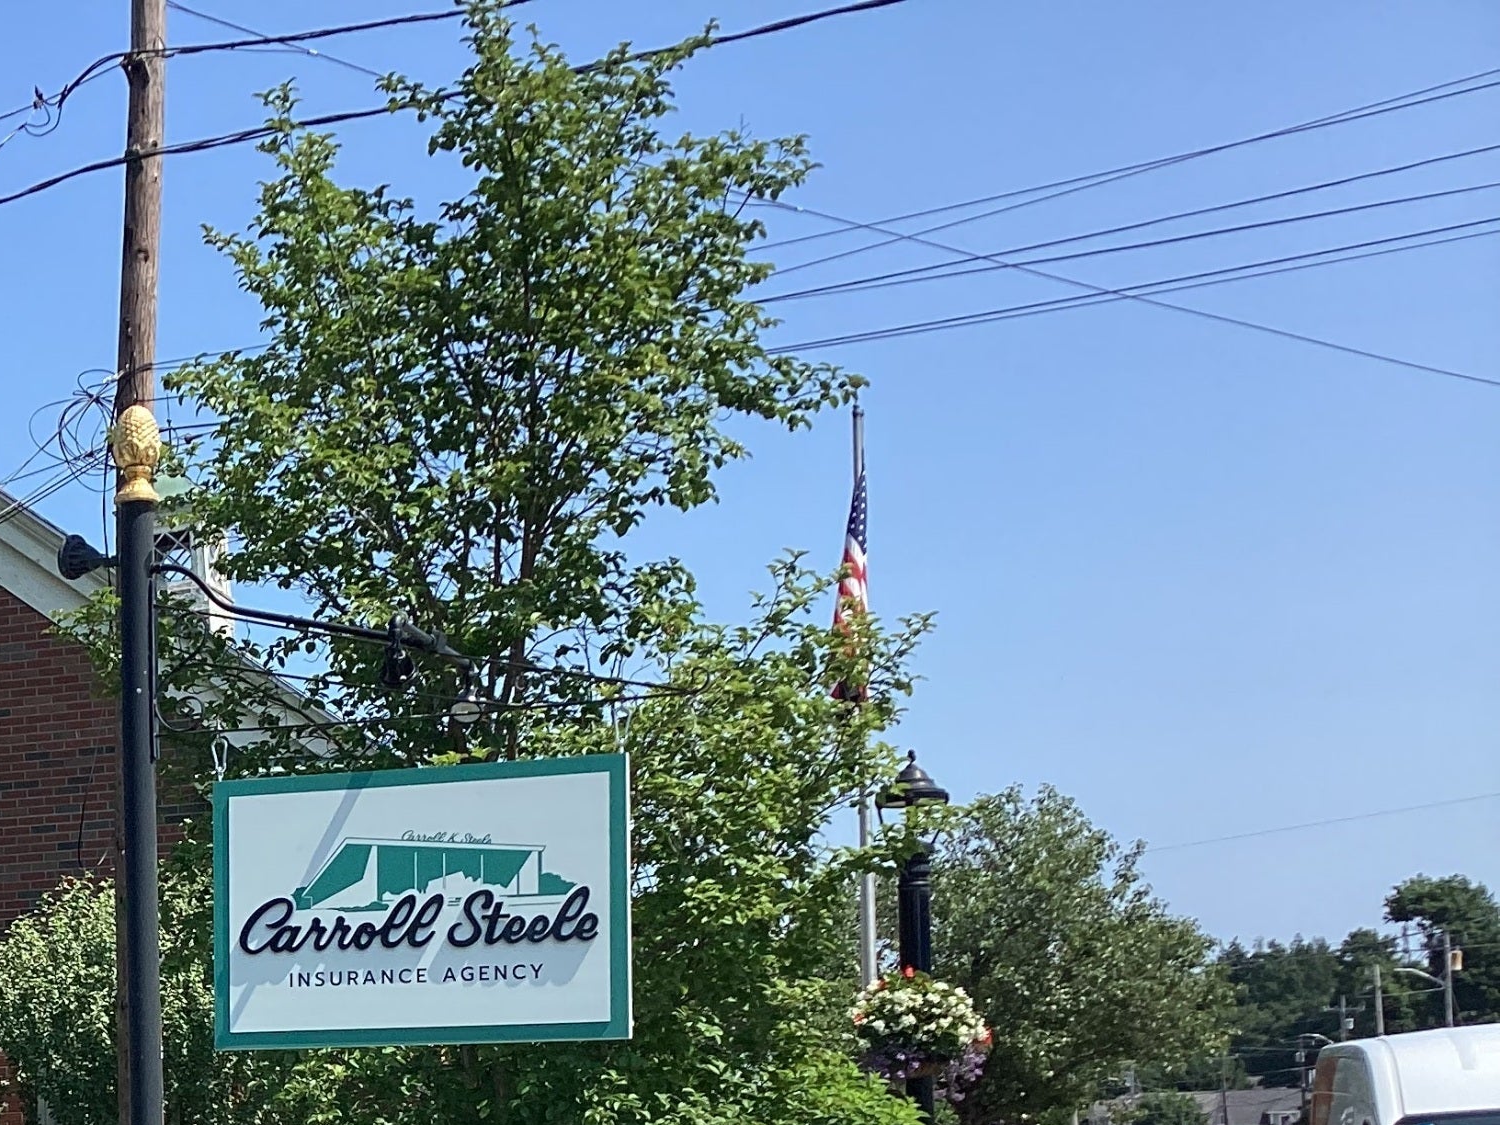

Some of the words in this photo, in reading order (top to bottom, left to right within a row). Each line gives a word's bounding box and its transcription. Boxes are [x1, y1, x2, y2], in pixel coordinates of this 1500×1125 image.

[448, 832, 459, 843] K
[239, 893, 444, 955] Carroll
[447, 886, 600, 948] Steele
[289, 967, 428, 988] INSURANCE
[442, 963, 546, 983] AGENCY
